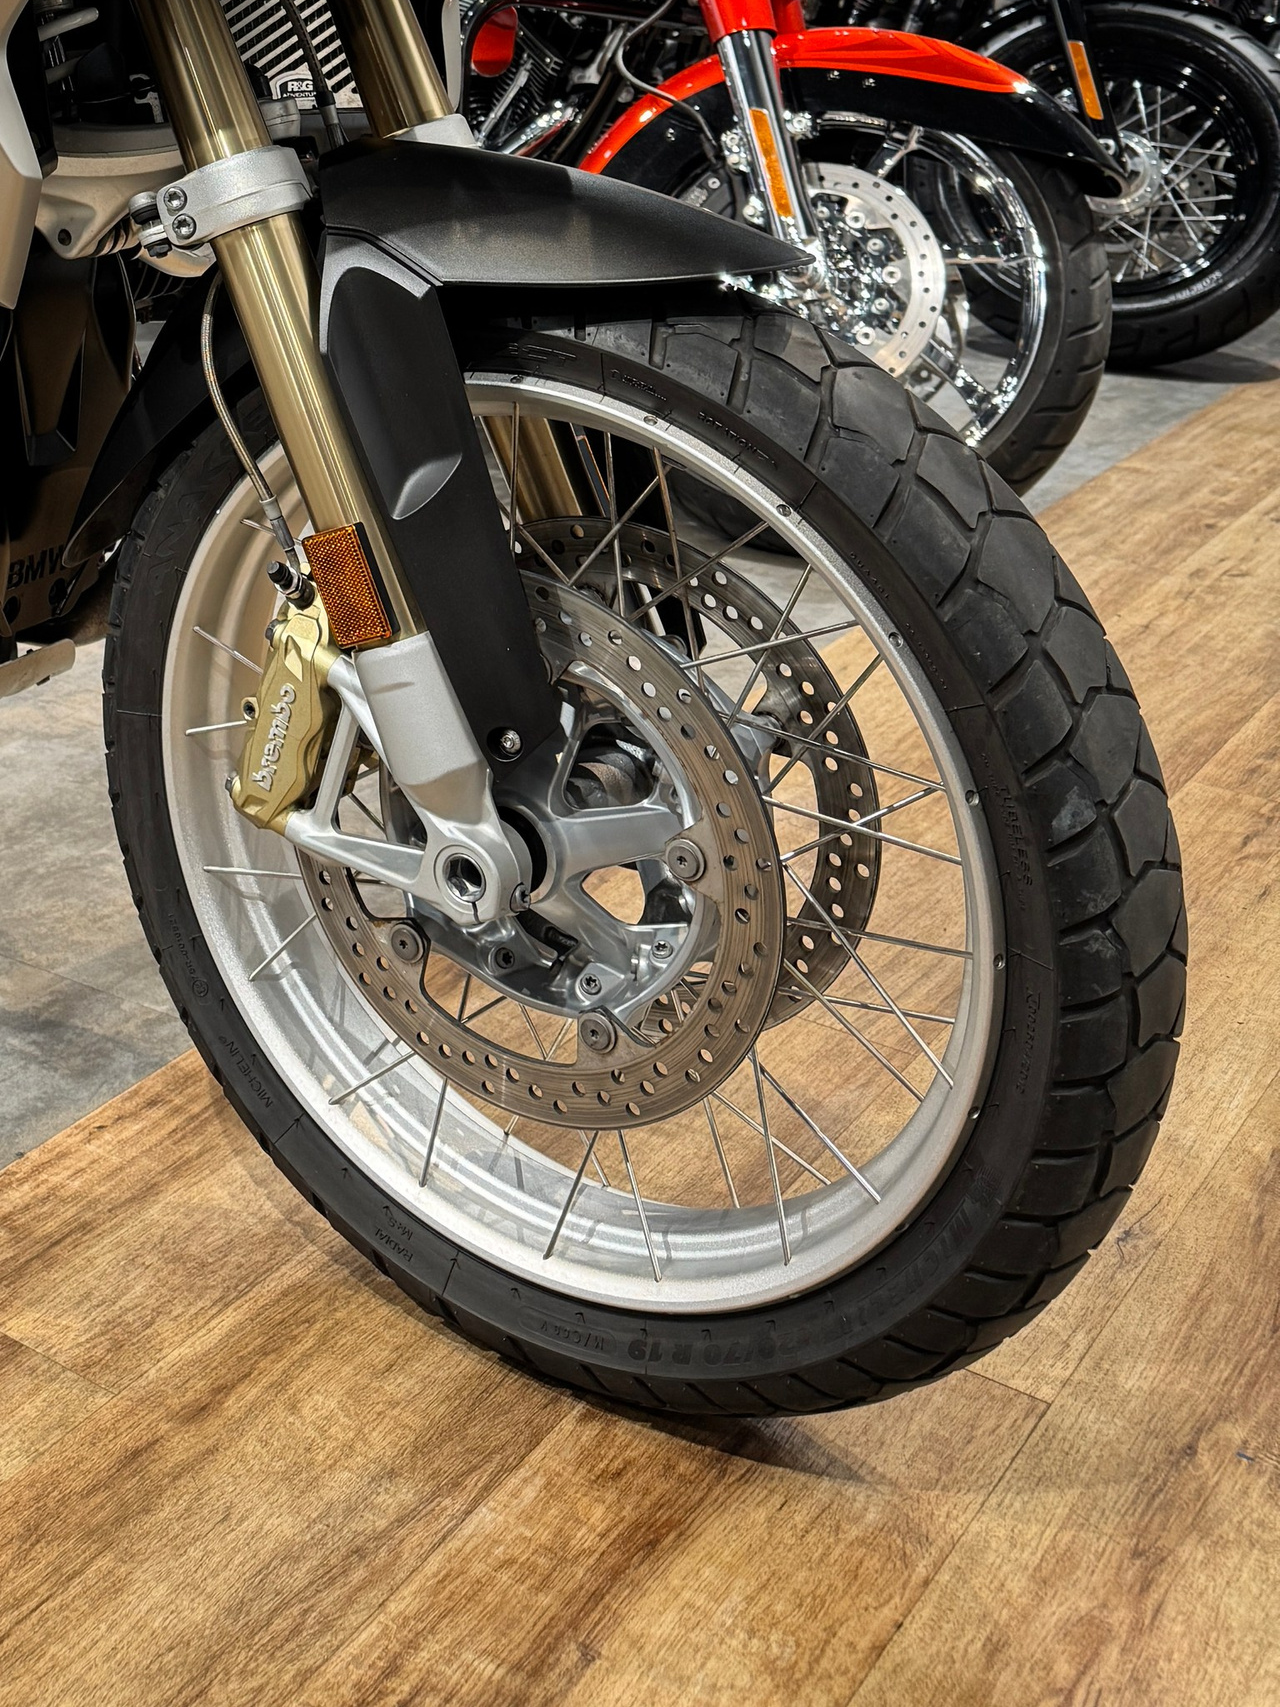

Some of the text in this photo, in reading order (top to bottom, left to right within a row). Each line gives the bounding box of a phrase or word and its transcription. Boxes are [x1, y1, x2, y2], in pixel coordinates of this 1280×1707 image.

[287, 80, 314, 92] R&G
[252, 682, 296, 792] brembo
[1000, 785, 1033, 886] TUBELESS
[223, 1039, 274, 1109] MICHELIN
[374, 1227, 414, 1263] RADIAL
[626, 1339, 663, 1364] 19
[671, 1342, 693, 1366] R
